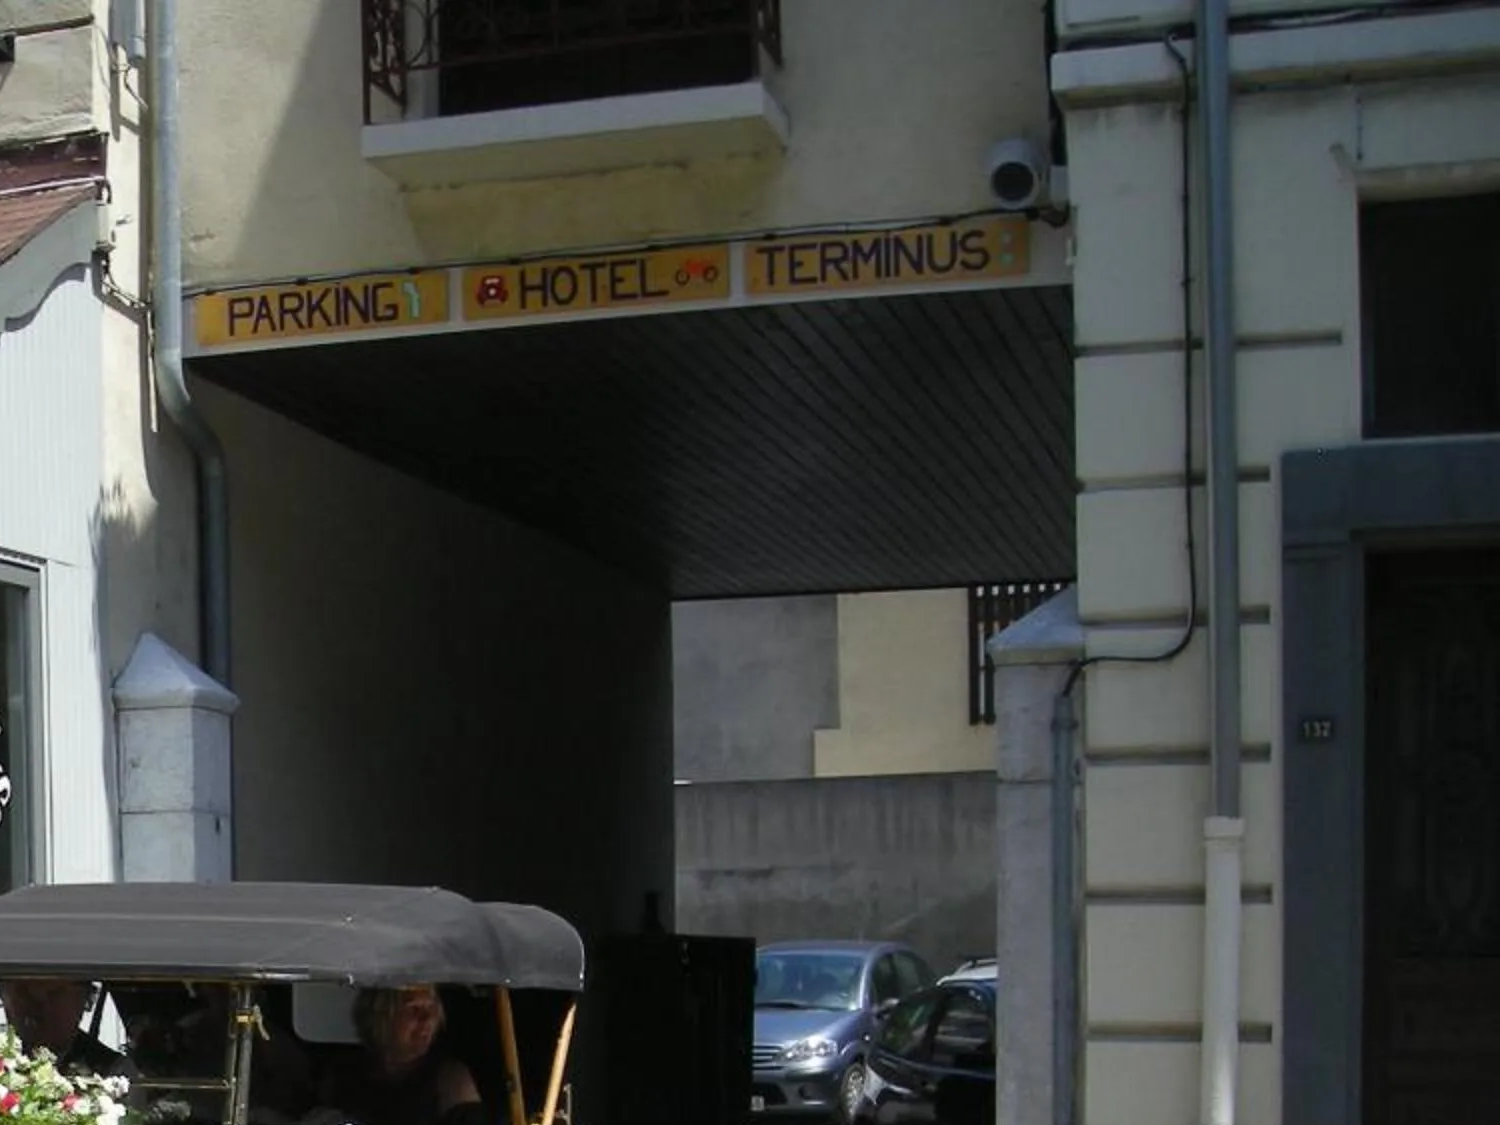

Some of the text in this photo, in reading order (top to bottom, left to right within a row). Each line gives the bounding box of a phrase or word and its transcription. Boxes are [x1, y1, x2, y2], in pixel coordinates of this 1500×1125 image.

[227, 227, 992, 337] PARKING HOTEL TERMINUS
